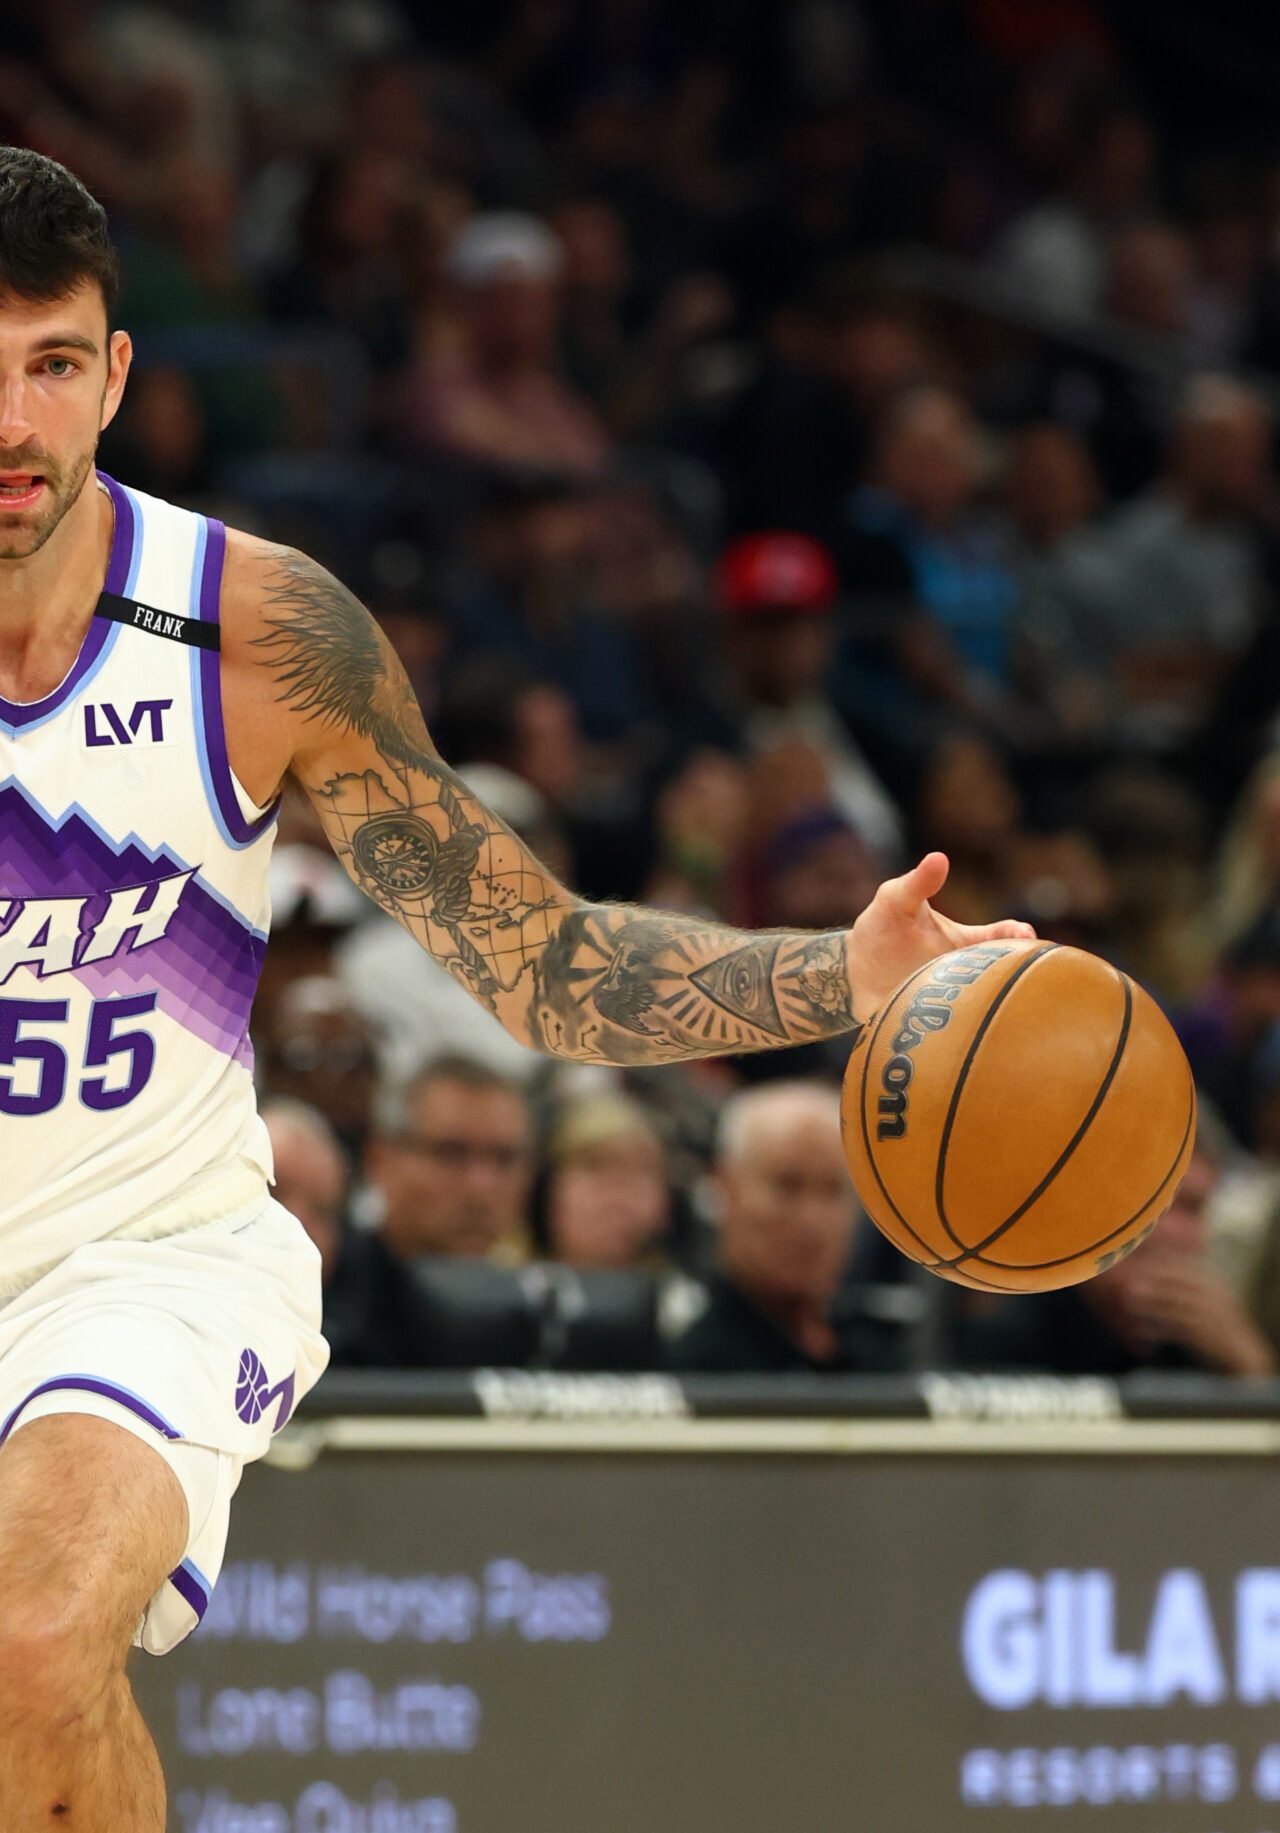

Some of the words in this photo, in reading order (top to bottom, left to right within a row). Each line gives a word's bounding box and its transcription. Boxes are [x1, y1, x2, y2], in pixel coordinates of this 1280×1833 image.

[133, 606, 186, 639] FRANK
[84, 699, 173, 747] LVT
[877, 945, 1016, 1142] Wilson
[961, 1566, 1225, 1710] GILA
[961, 1745, 1238, 1808] RESORTS
